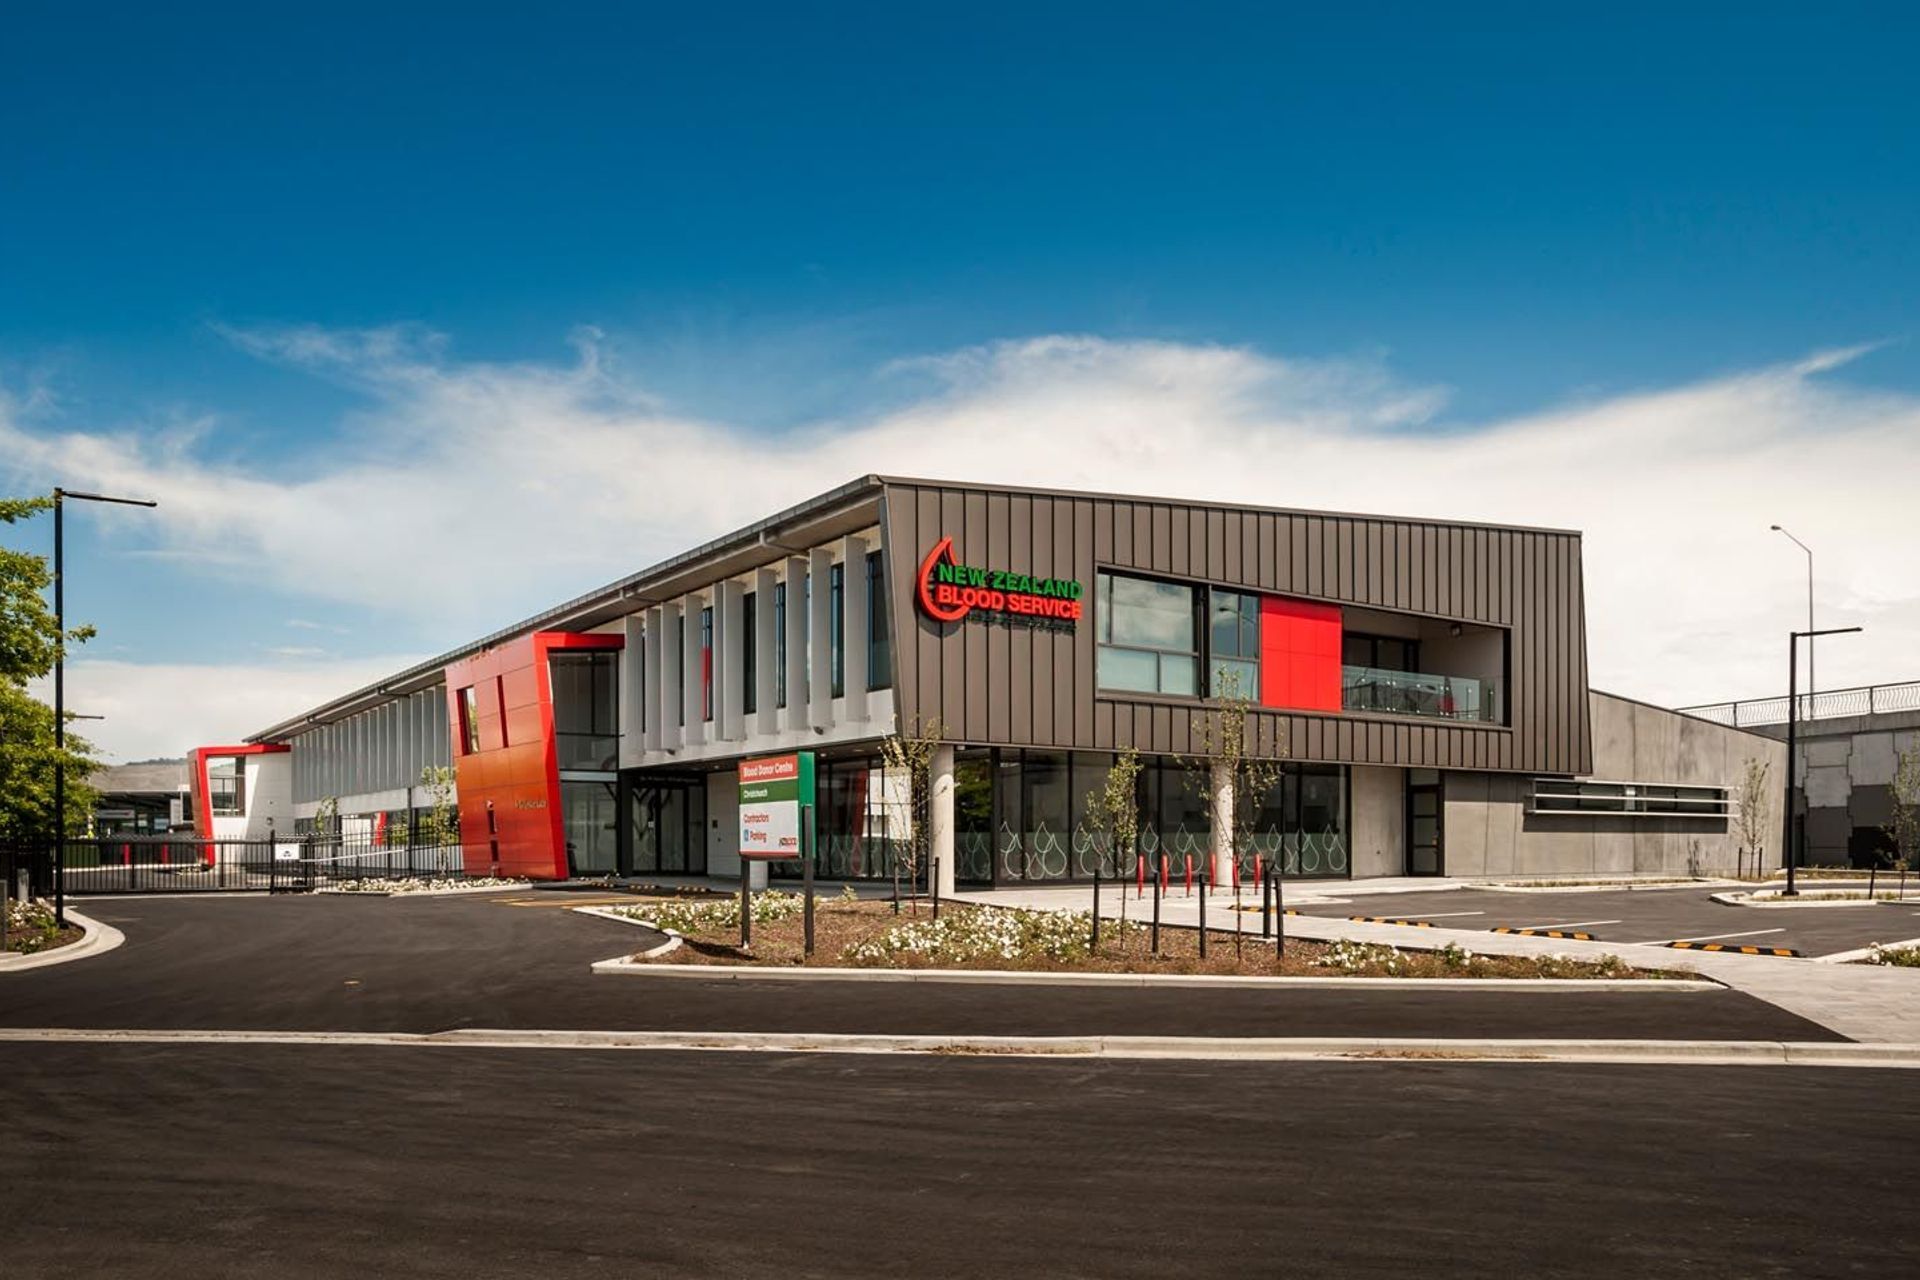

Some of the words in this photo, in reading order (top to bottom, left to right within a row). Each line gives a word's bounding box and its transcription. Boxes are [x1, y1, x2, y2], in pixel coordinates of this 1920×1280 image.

[938, 563, 987, 586] NEW
[993, 570, 1084, 599] ZEALAND
[937, 585, 1004, 610] BLOOD
[1008, 594, 1083, 620] SERVICE
[743, 766, 758, 778] Blood
[758, 764, 774, 776] Donor
[774, 761, 793, 774] Centre
[749, 830, 767, 843] Parking
